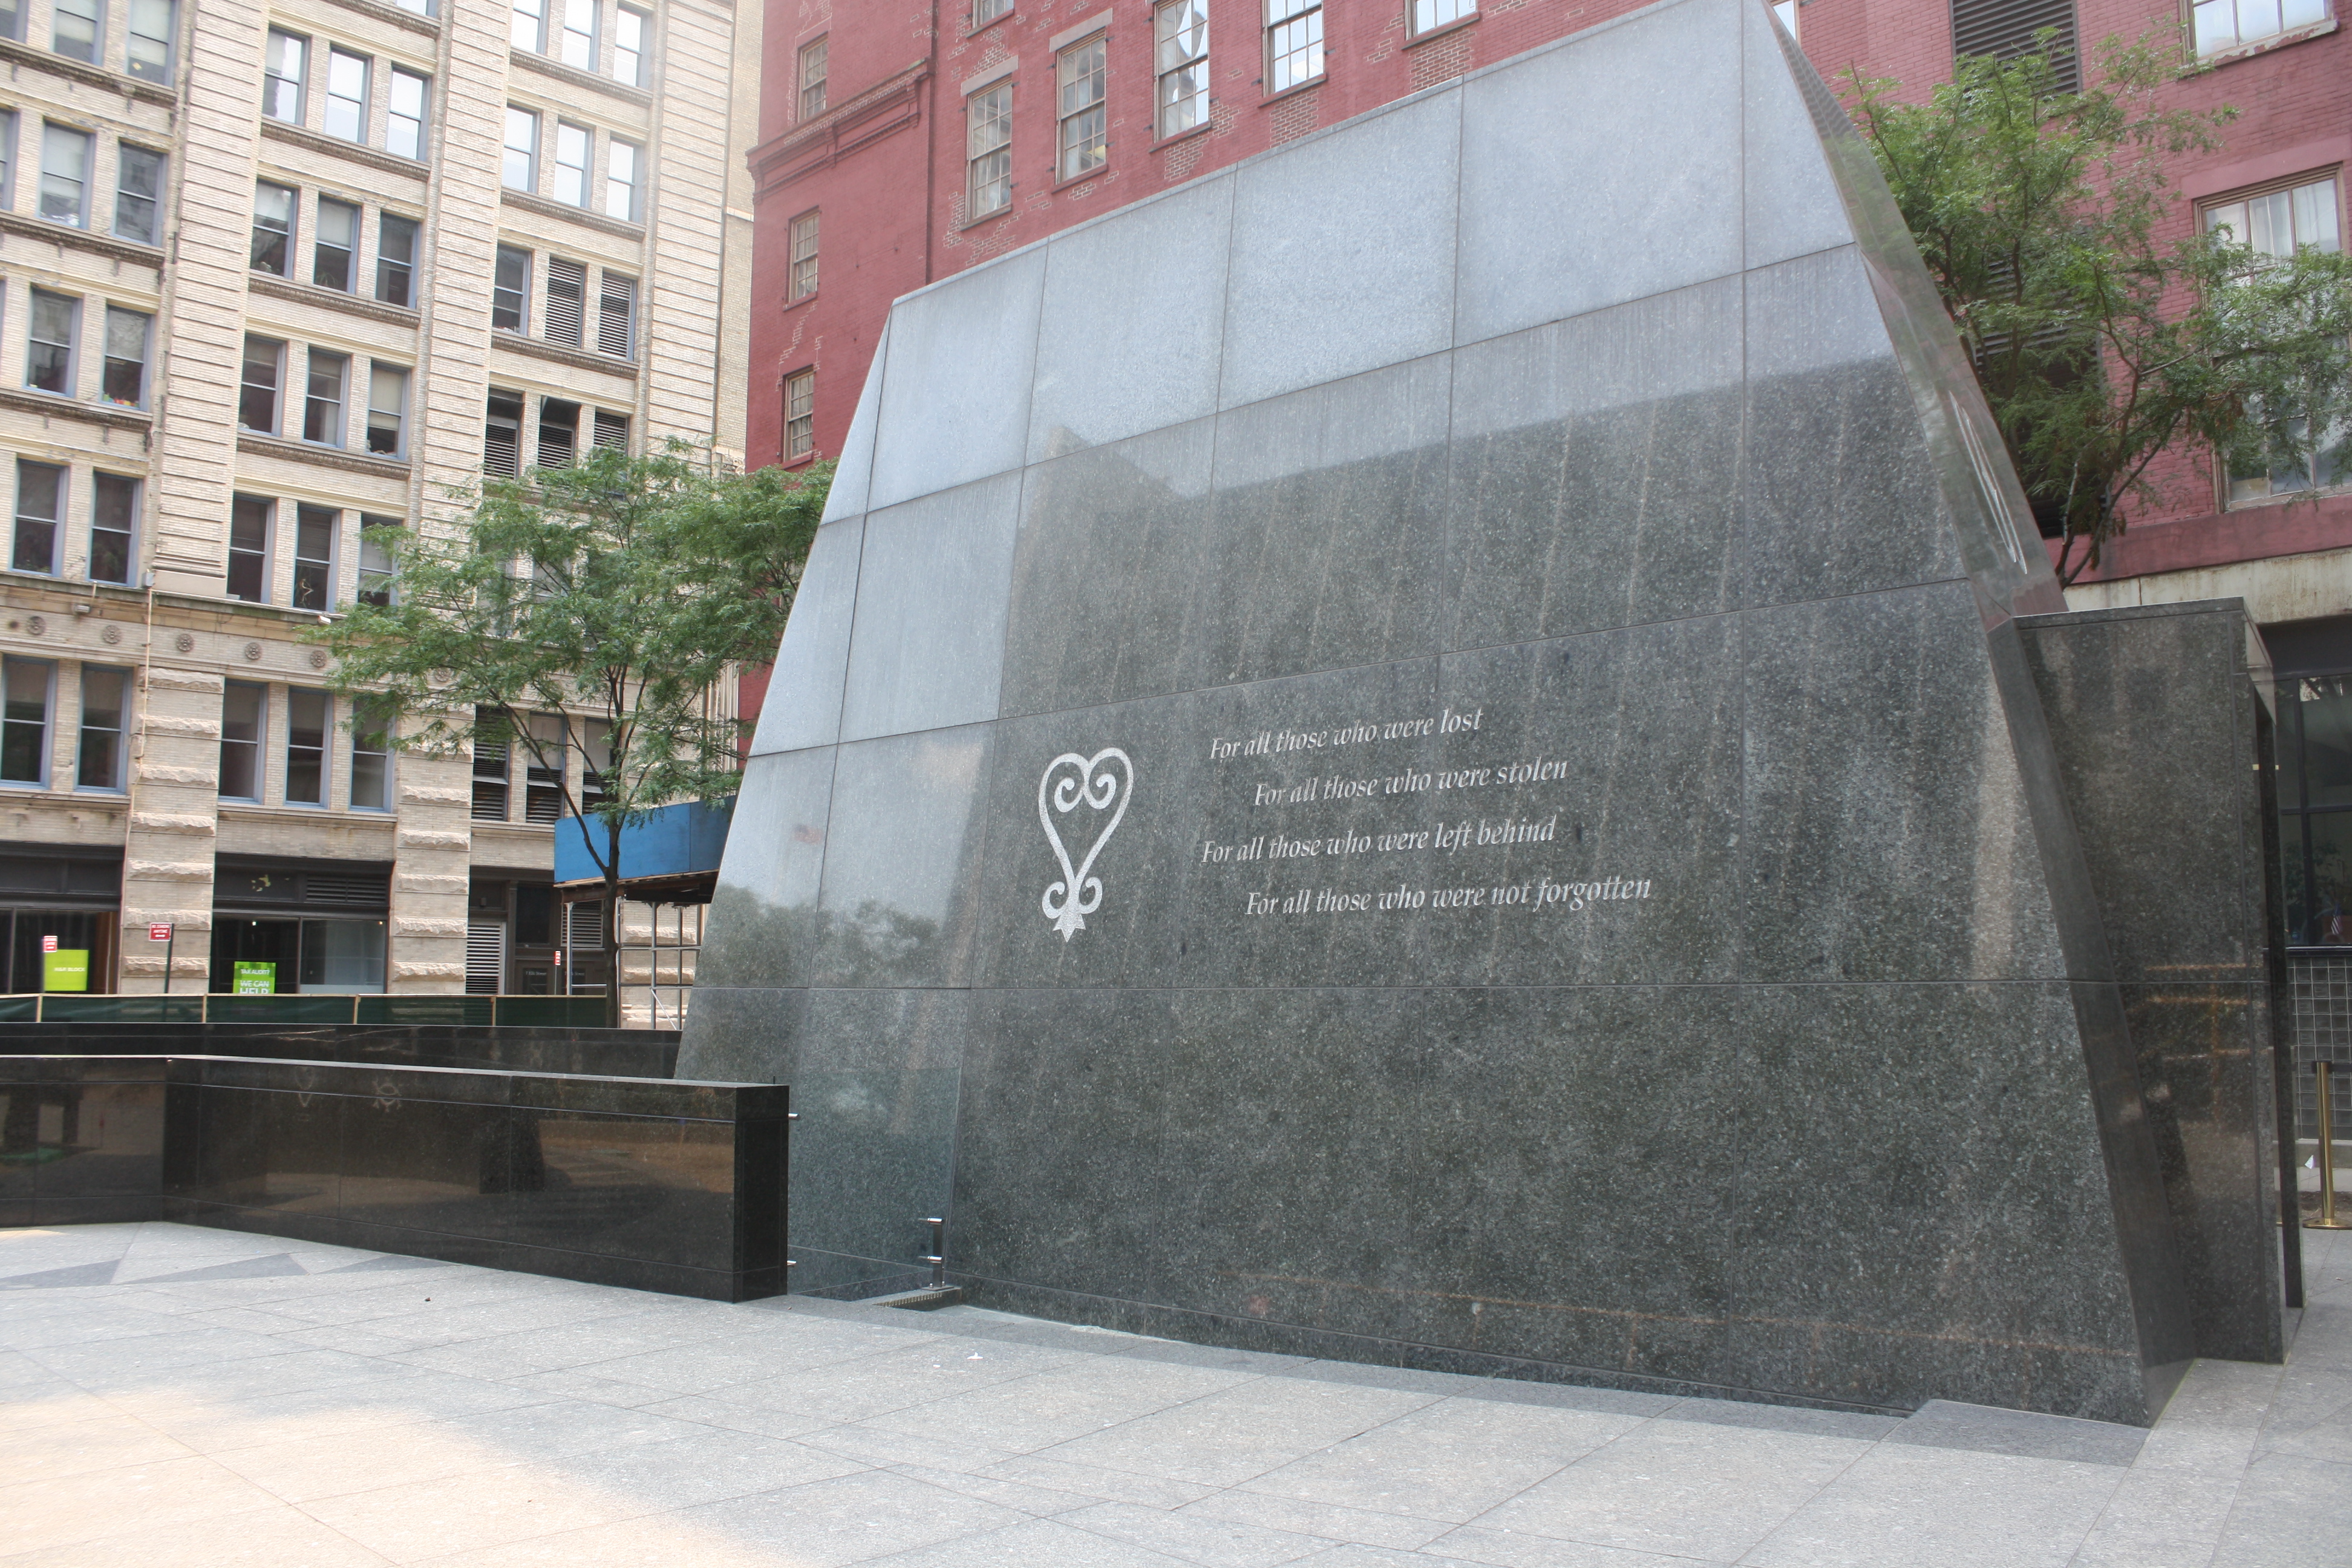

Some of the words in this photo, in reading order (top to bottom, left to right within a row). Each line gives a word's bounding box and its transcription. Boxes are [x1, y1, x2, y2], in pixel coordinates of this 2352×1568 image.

[1210, 738, 1241, 759] For
[1244, 730, 1271, 756] all
[1276, 727, 1328, 753] those
[1334, 719, 1377, 745] who
[1383, 717, 1434, 740] were
[1440, 707, 1483, 734] lost
[1254, 783, 1287, 806] For
[1290, 776, 1319, 803] all
[1324, 774, 1378, 800] those
[1385, 768, 1431, 794] who
[1436, 768, 1491, 789] were
[1497, 756, 1567, 784] stolen
[1201, 840, 1234, 863] For
[1236, 835, 1265, 861] all
[1269, 834, 1321, 859] those
[1327, 829, 1371, 855] who
[1377, 831, 1429, 852] were
[1434, 820, 1473, 856] left
[1478, 814, 1557, 845] behind
[1244, 892, 1279, 915] For
[1282, 889, 1312, 914] all
[1316, 887, 1372, 912] those
[1379, 883, 1425, 909] who
[1432, 887, 1486, 907] were
[1491, 880, 1532, 905] not
[1532, 875, 1651, 912] forgotten
